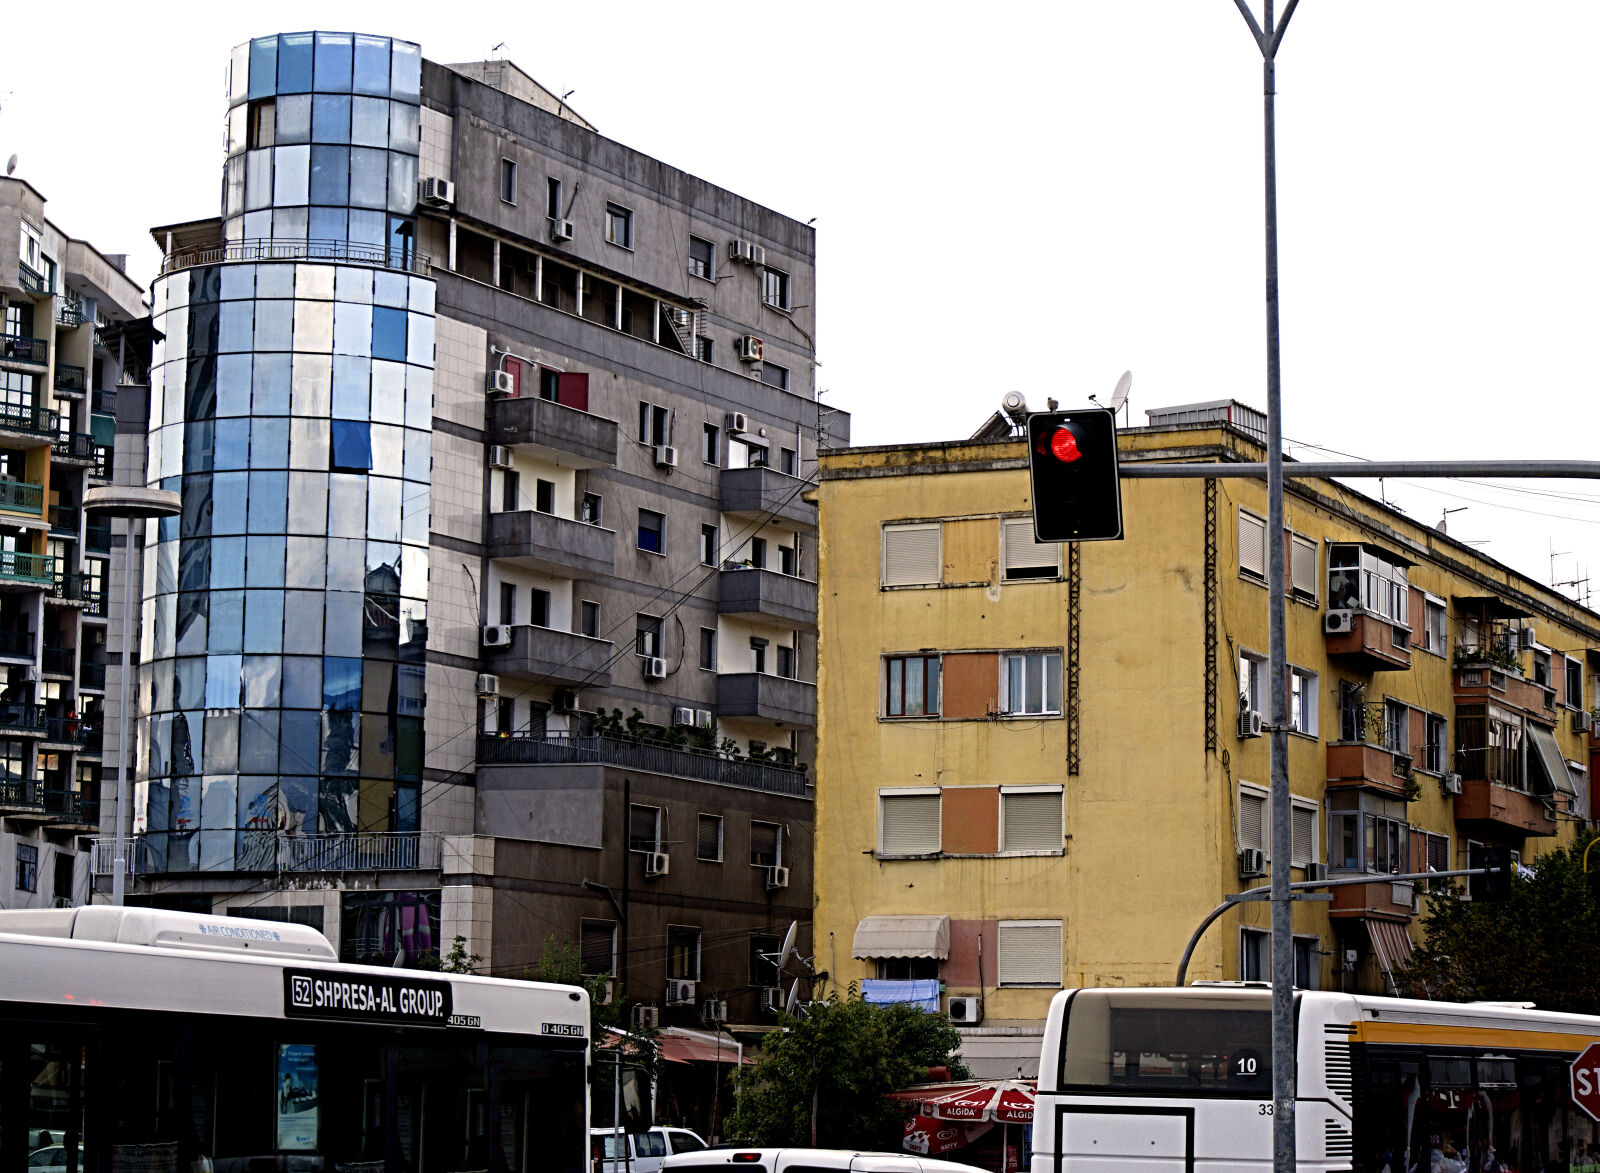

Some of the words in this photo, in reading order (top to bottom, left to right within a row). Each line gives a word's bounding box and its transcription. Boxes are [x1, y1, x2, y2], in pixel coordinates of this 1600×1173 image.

[207, 925, 220, 935] AIR
[220, 926, 273, 941] CONDITIONED
[295, 980, 310, 1003] 52
[315, 979, 397, 1013] SHPRESA-AL
[1237, 1057, 1257, 1073] 10
